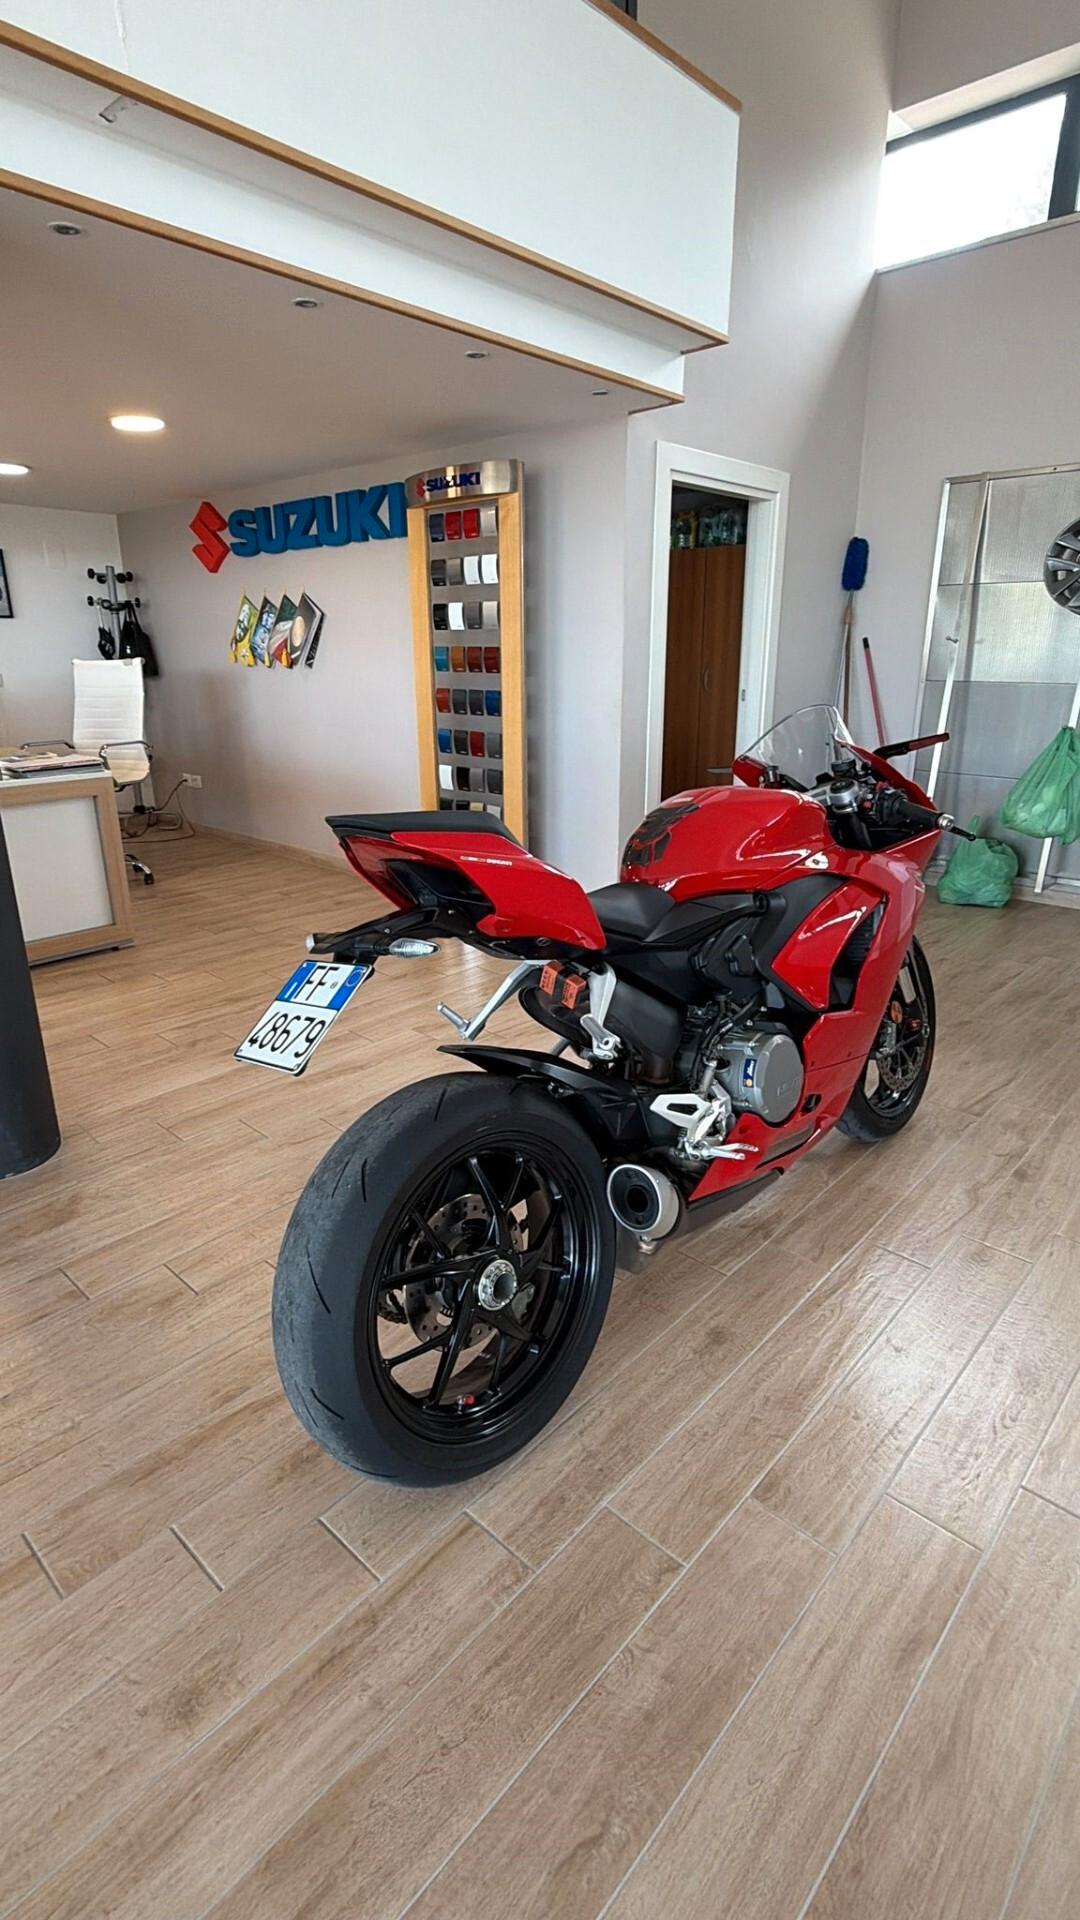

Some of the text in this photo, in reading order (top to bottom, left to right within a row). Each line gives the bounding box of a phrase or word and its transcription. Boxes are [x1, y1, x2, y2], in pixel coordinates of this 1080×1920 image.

[426, 471, 481, 492] SUZUKI
[228, 482, 408, 557] SUZUKI
[293, 964, 340, 1001] FF
[247, 1011, 327, 1059] 48679
